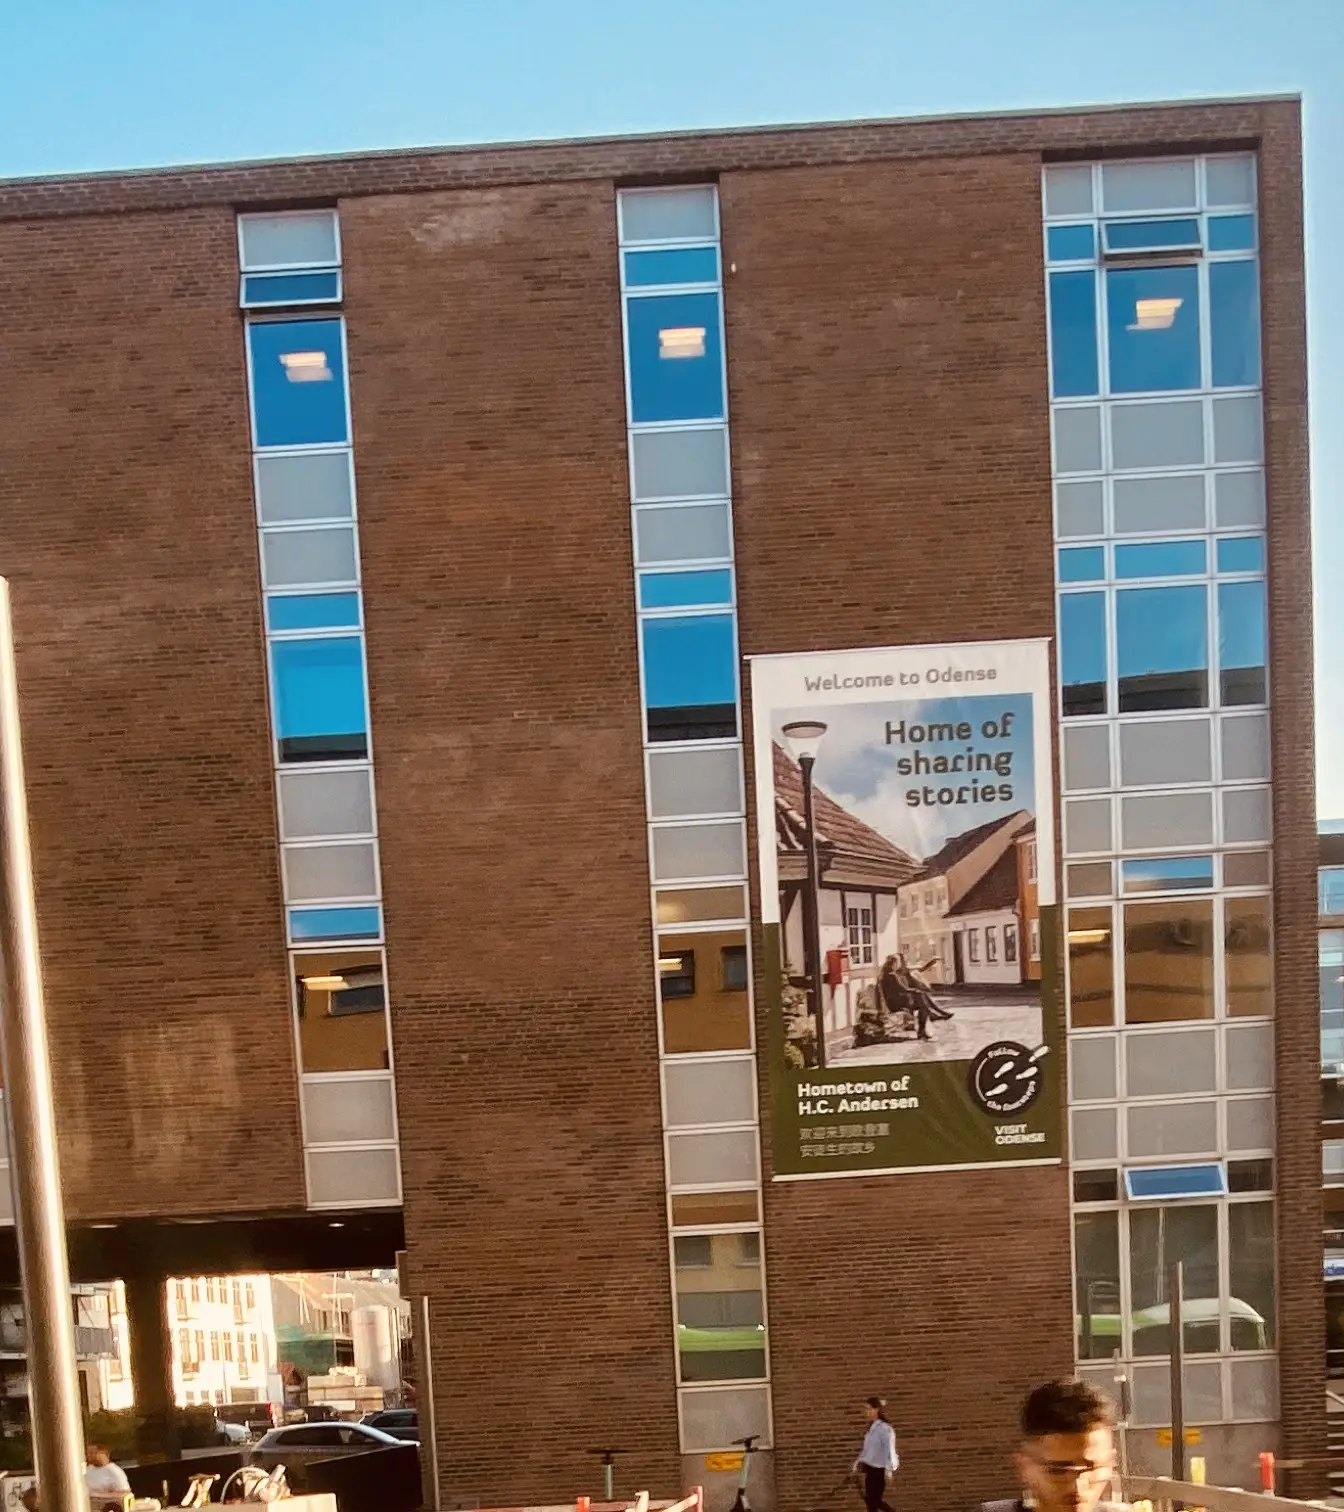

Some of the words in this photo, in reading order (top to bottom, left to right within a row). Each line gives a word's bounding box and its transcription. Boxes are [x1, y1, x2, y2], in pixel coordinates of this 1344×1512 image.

[804, 673, 894, 691] Welcome
[899, 672, 920, 686] to
[925, 666, 997, 684] Odense
[885, 720, 972, 745] Home
[981, 712, 1014, 739] of
[896, 747, 1013, 777] sharing
[906, 778, 1013, 807] stories
[797, 1081, 887, 1098] Hometown
[890, 1075, 911, 1091] of
[798, 1099, 834, 1116] H.C.
[837, 1096, 919, 1113] Andersen
[994, 1123, 1027, 1135] VISIT
[995, 1132, 1045, 1145] ODENSE
